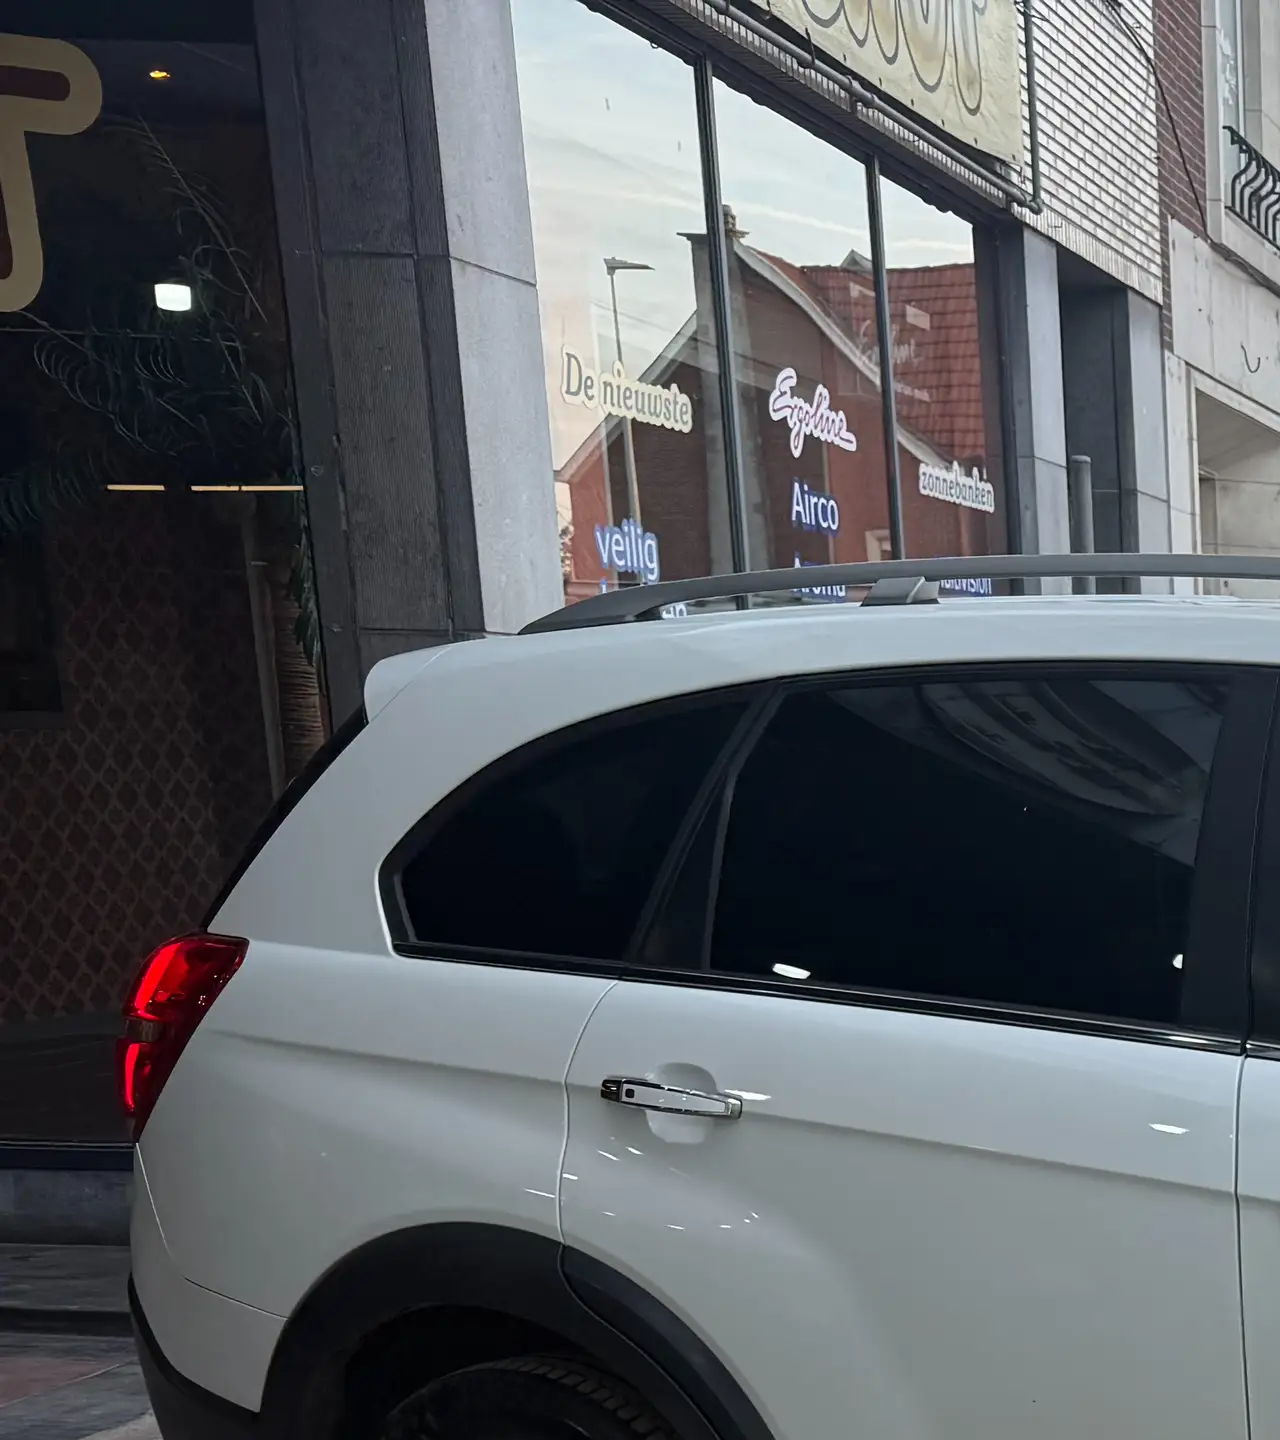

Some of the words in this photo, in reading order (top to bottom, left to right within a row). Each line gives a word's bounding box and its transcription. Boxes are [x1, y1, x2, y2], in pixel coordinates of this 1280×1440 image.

[565, 352, 595, 401] De
[602, 368, 690, 426] nieuwste
[773, 375, 854, 450] Ergoline
[792, 482, 840, 530] Airco
[921, 468, 993, 507] zonnebanken
[596, 525, 658, 581] veilig
